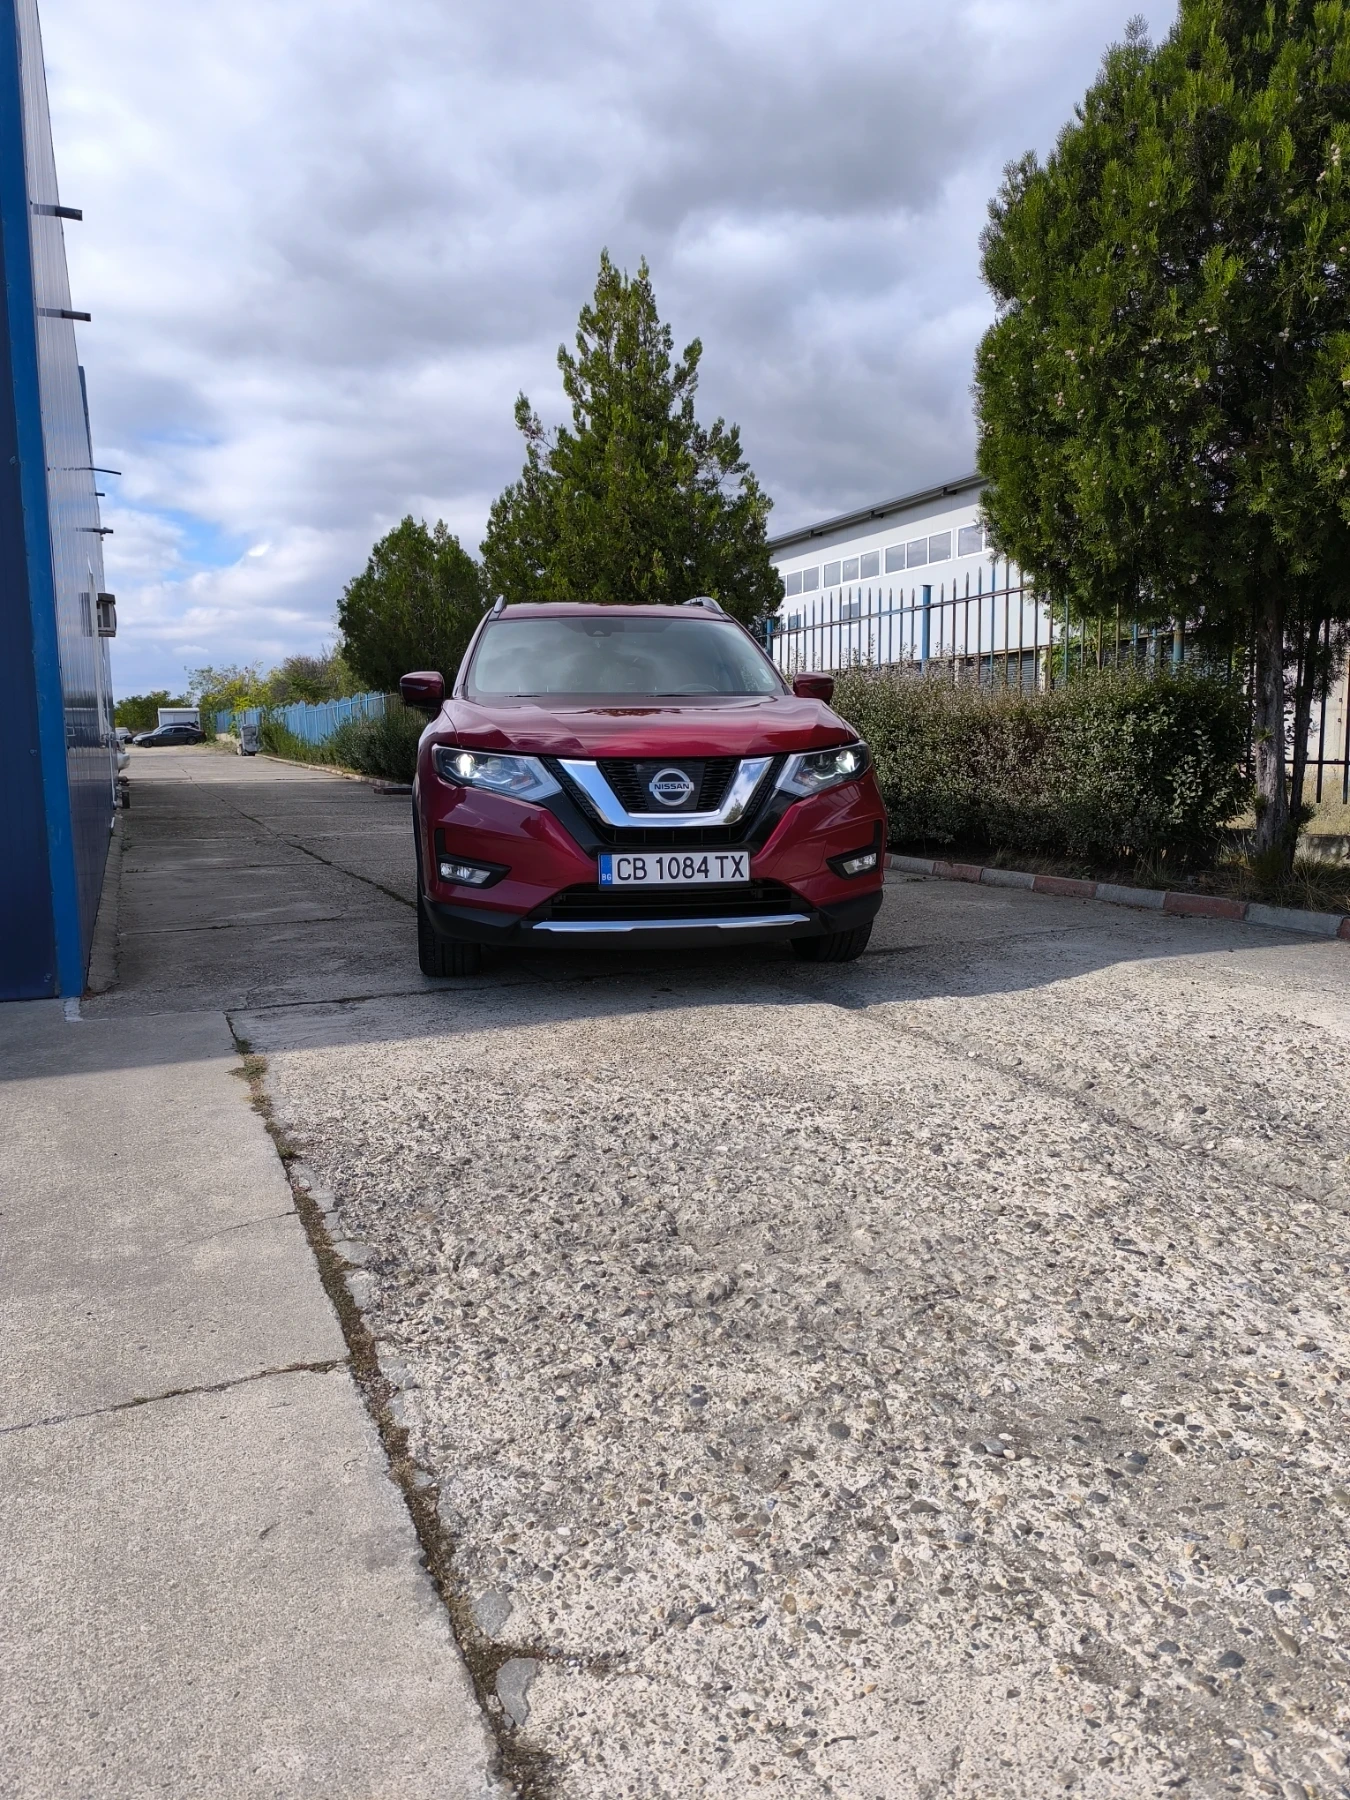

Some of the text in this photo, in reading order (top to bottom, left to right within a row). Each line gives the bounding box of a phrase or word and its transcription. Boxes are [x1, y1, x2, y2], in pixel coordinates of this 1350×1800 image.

[616, 855, 745, 881] CB 1084 TX
[601, 873, 612, 881] BG
